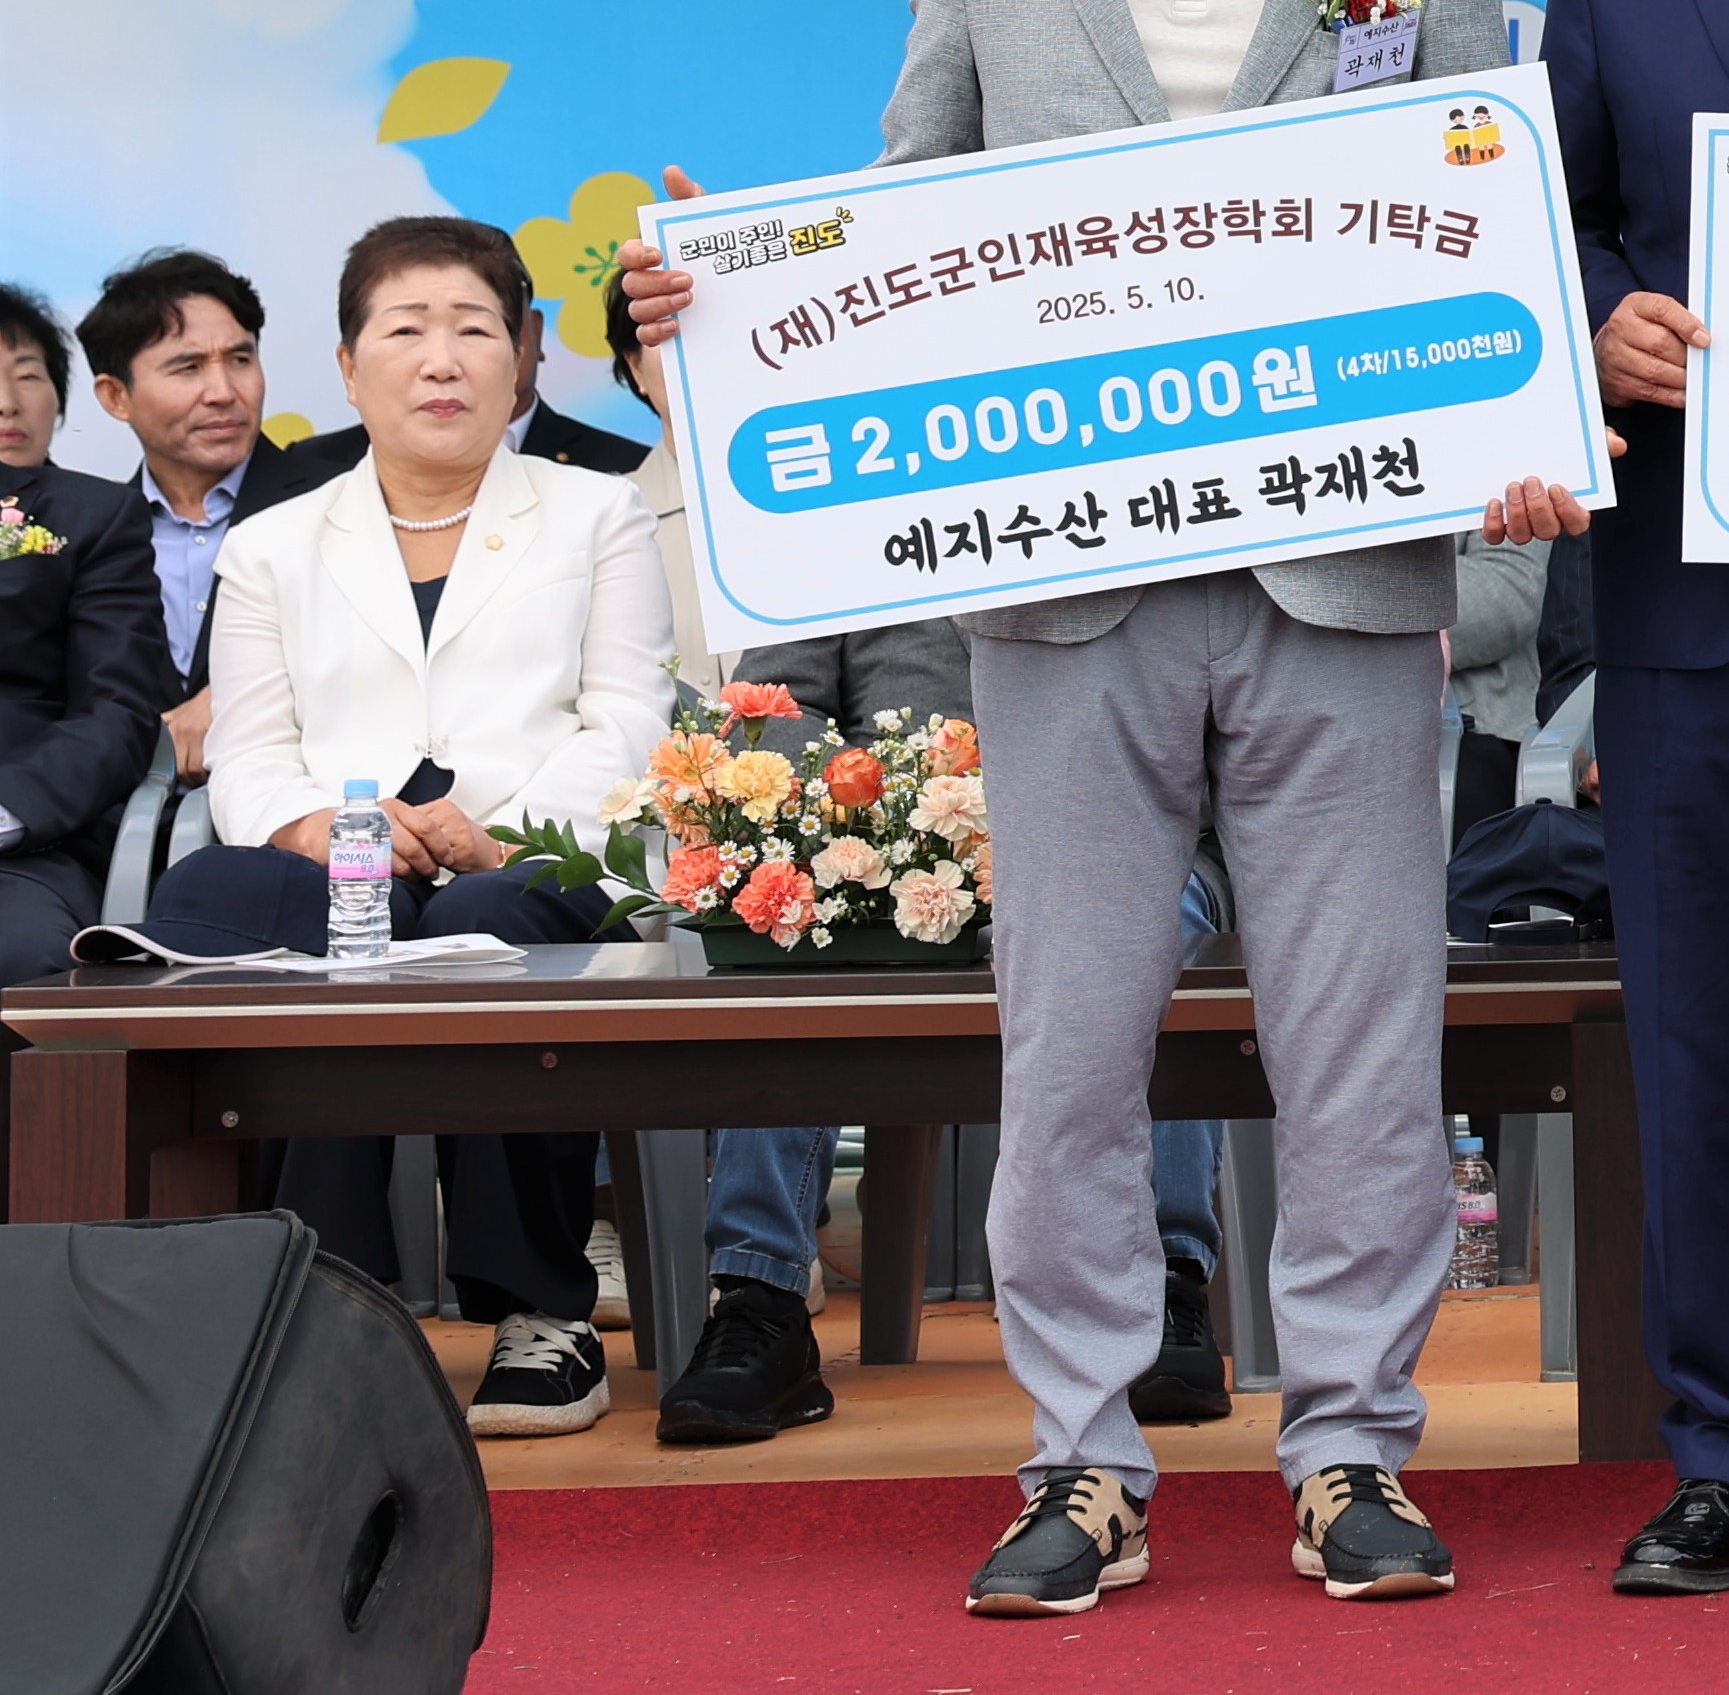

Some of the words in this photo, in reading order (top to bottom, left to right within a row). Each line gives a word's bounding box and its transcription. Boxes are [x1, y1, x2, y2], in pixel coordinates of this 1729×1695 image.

[1363, 21, 1400, 40] 예지수산
[1344, 42, 1406, 78] 곽재천
[680, 231, 736, 261] 군민이
[738, 219, 783, 247] 주인!
[713, 240, 786, 275] 살기좋은
[788, 219, 847, 256] 진도
[751, 197, 1313, 371] (재)진도군인재육성장학회
[1337, 199, 1480, 259] 기탁금
[1037, 291, 1115, 324] 2025.
[1126, 284, 1154, 311] 5.
[1163, 277, 1204, 303] 10.
[765, 423, 832, 493] 금
[851, 344, 1318, 476] 2,000,000원
[1337, 329, 1522, 381] (4차/15,000천원)
[884, 490, 1108, 575] 예지수산
[1127, 477, 1243, 535] 대표
[1257, 437, 1426, 517] 곽재천
